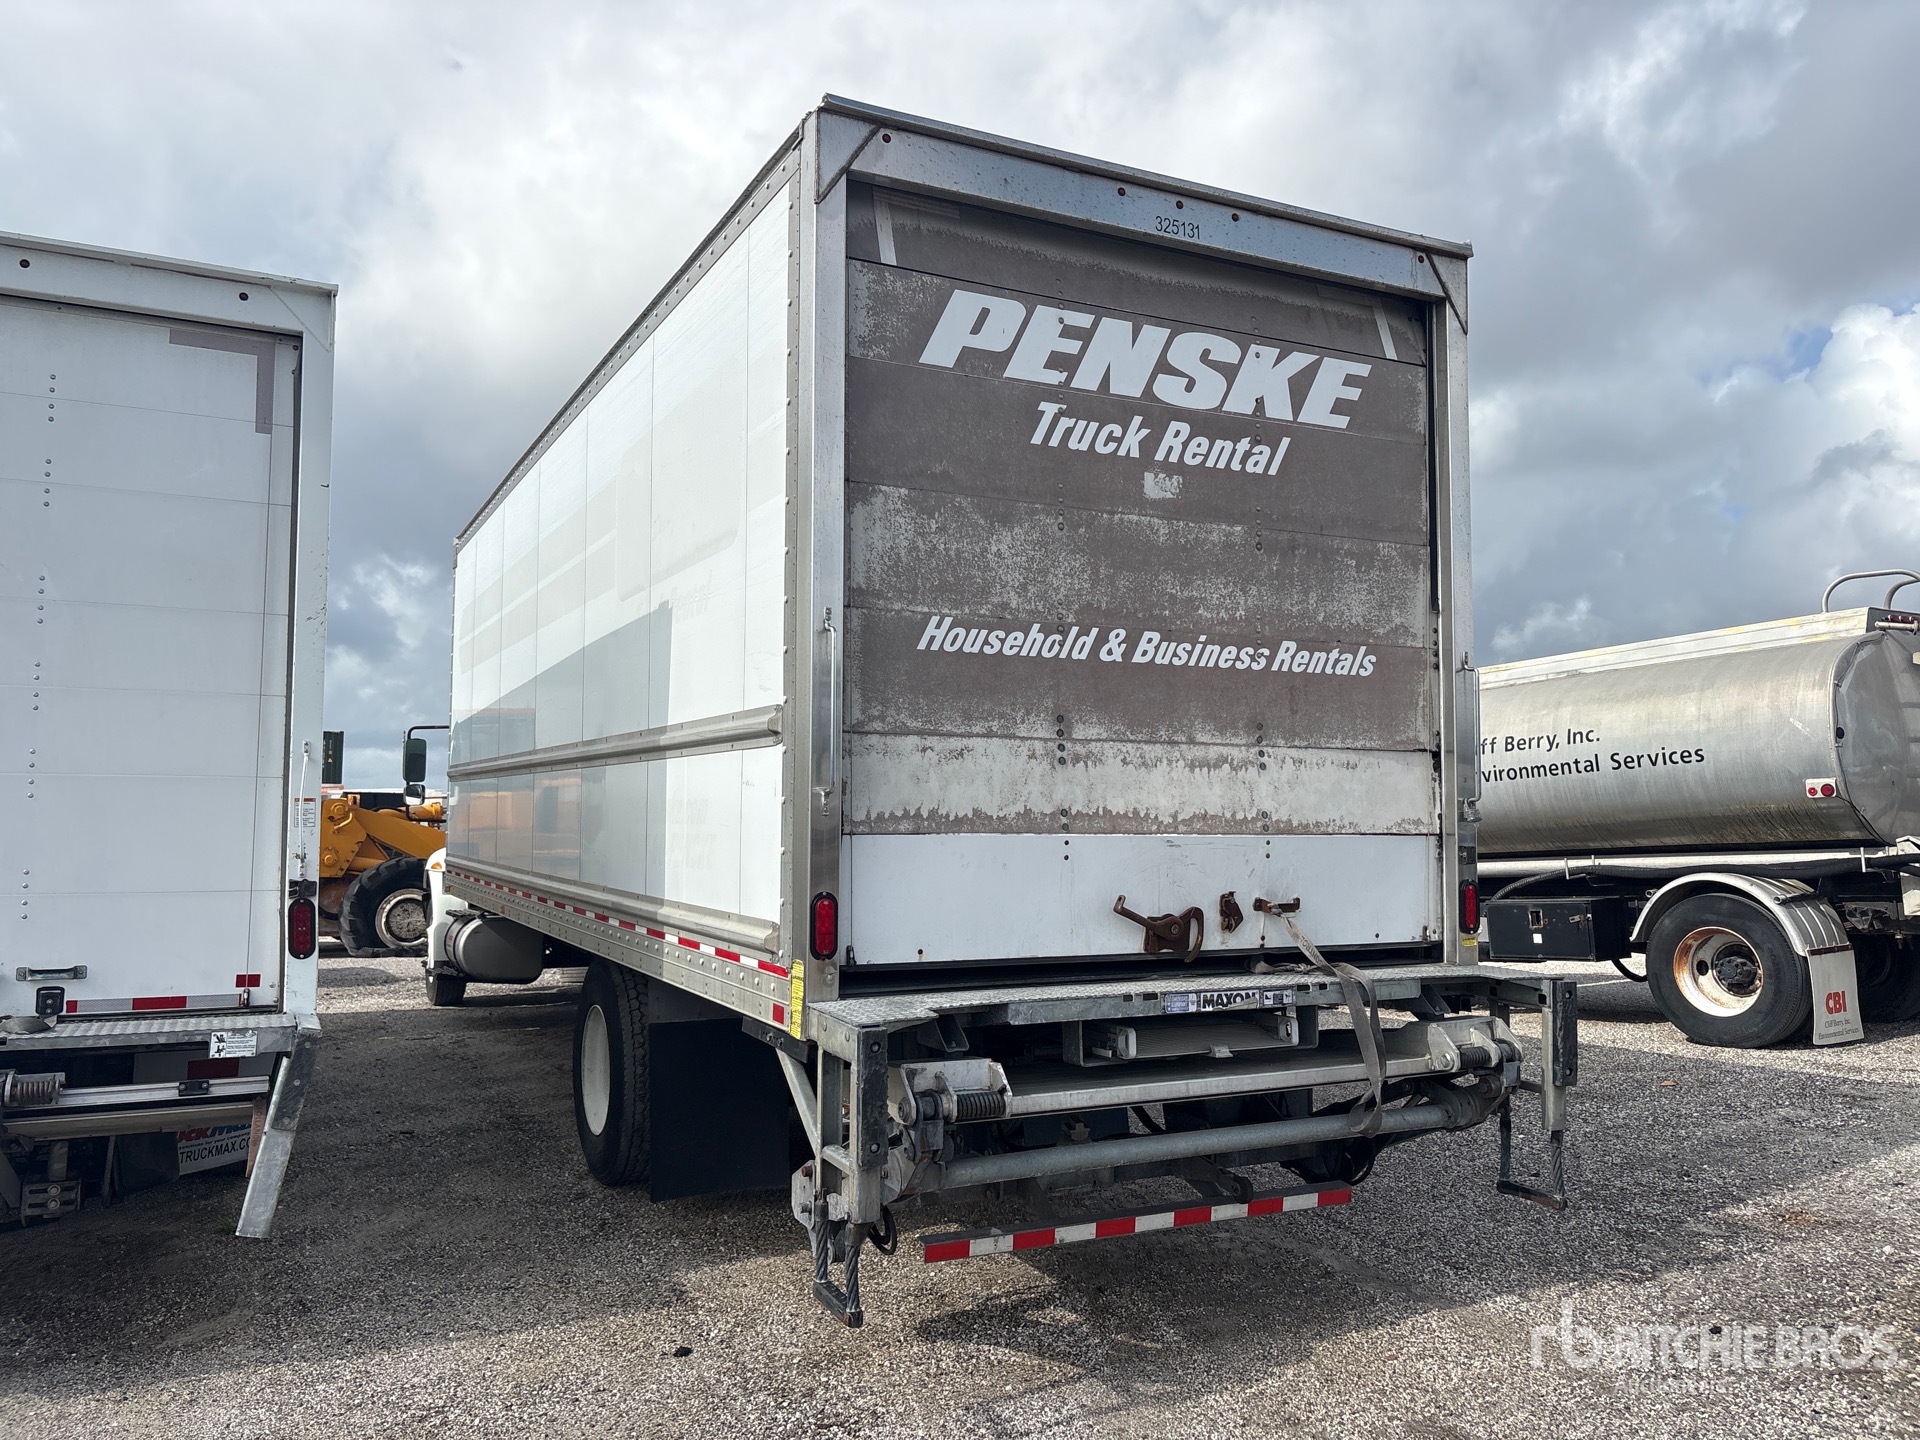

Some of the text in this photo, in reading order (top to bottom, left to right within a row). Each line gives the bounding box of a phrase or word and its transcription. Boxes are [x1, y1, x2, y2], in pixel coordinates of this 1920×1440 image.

[1155, 215, 1200, 240] 325131
[918, 289, 1372, 429] PENSKE
[1030, 402, 1291, 476] Truck Rental
[916, 615, 1377, 677] Household & Business Rentals
[1480, 728, 1600, 755] ff Berry, Inc.
[1481, 747, 1705, 783] vironmental Services
[1202, 991, 1256, 1009] MAXON
[1825, 990, 1847, 1015] CBI
[179, 1136, 251, 1164] TRUCKMAX.CO
